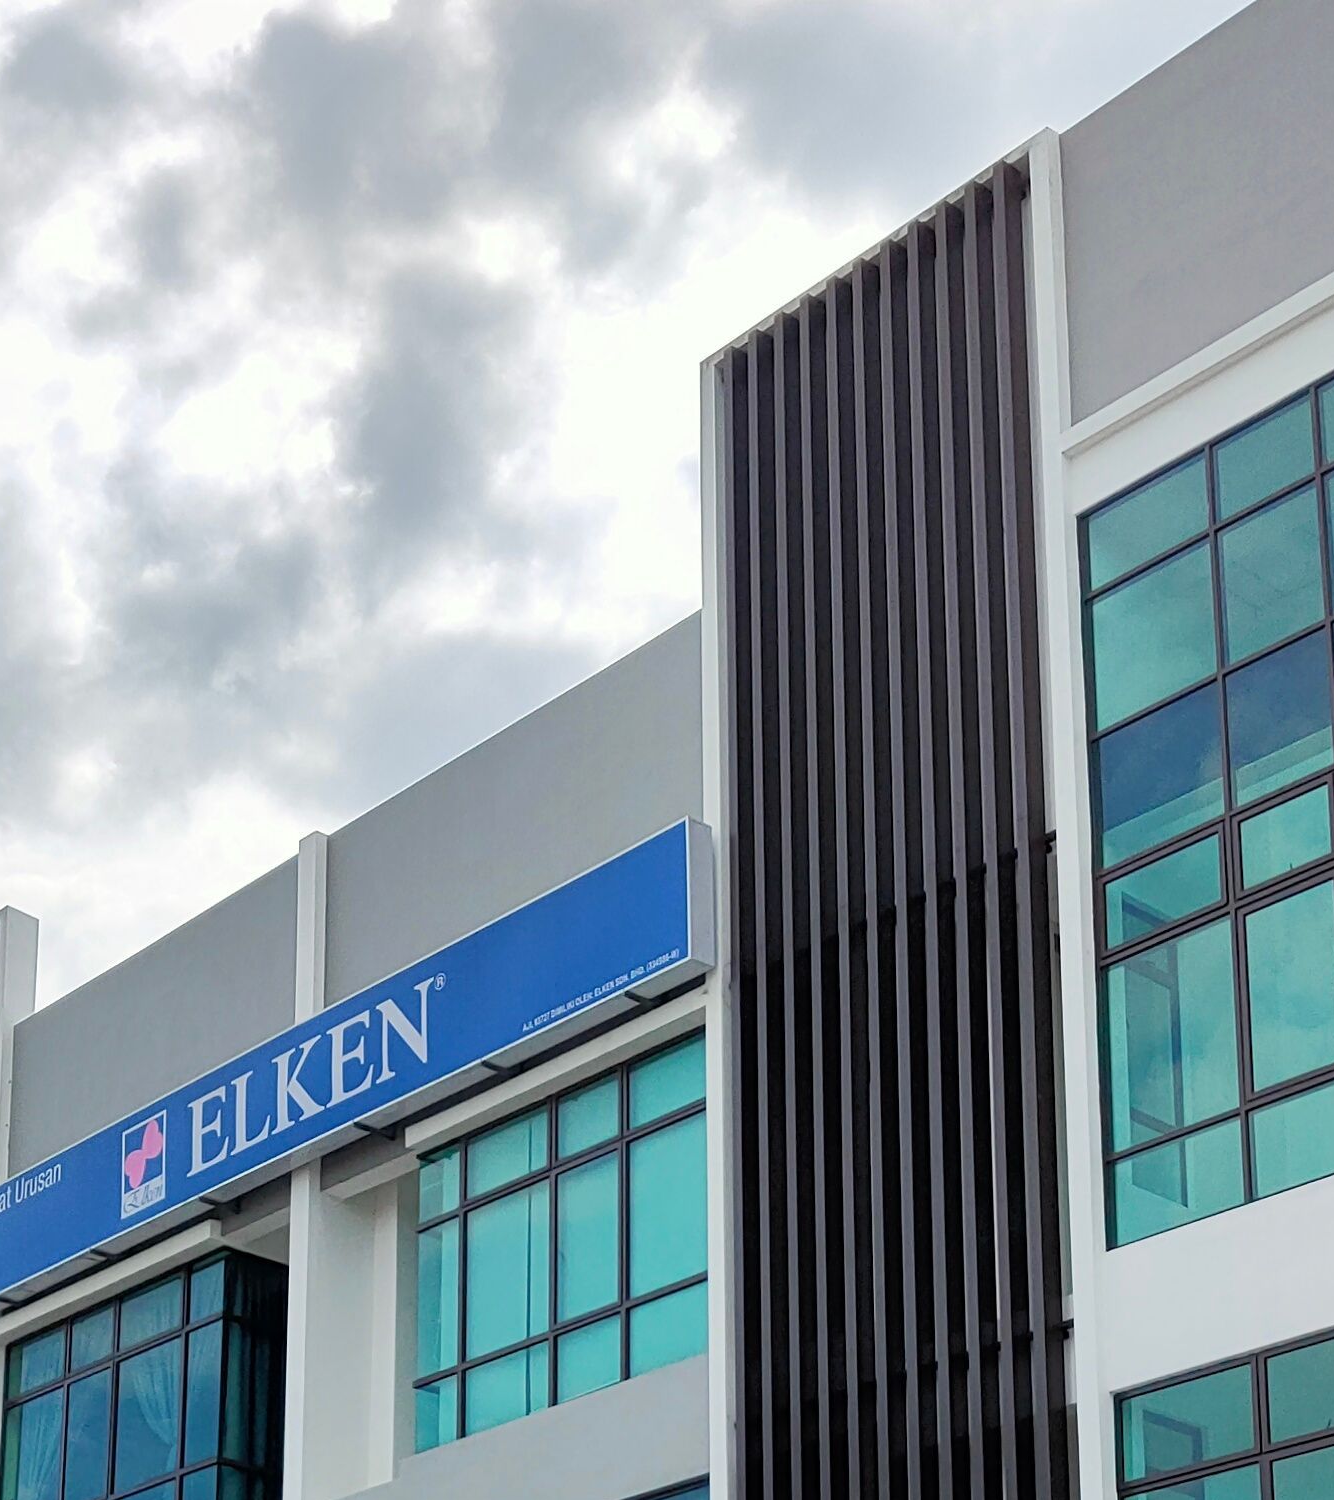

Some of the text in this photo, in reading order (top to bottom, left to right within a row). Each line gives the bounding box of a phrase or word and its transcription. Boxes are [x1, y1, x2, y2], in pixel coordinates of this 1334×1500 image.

[594, 980, 615, 997] ELKEN
[186, 976, 435, 1178] ELKEN
[15, 1163, 62, 1204] Urusan
